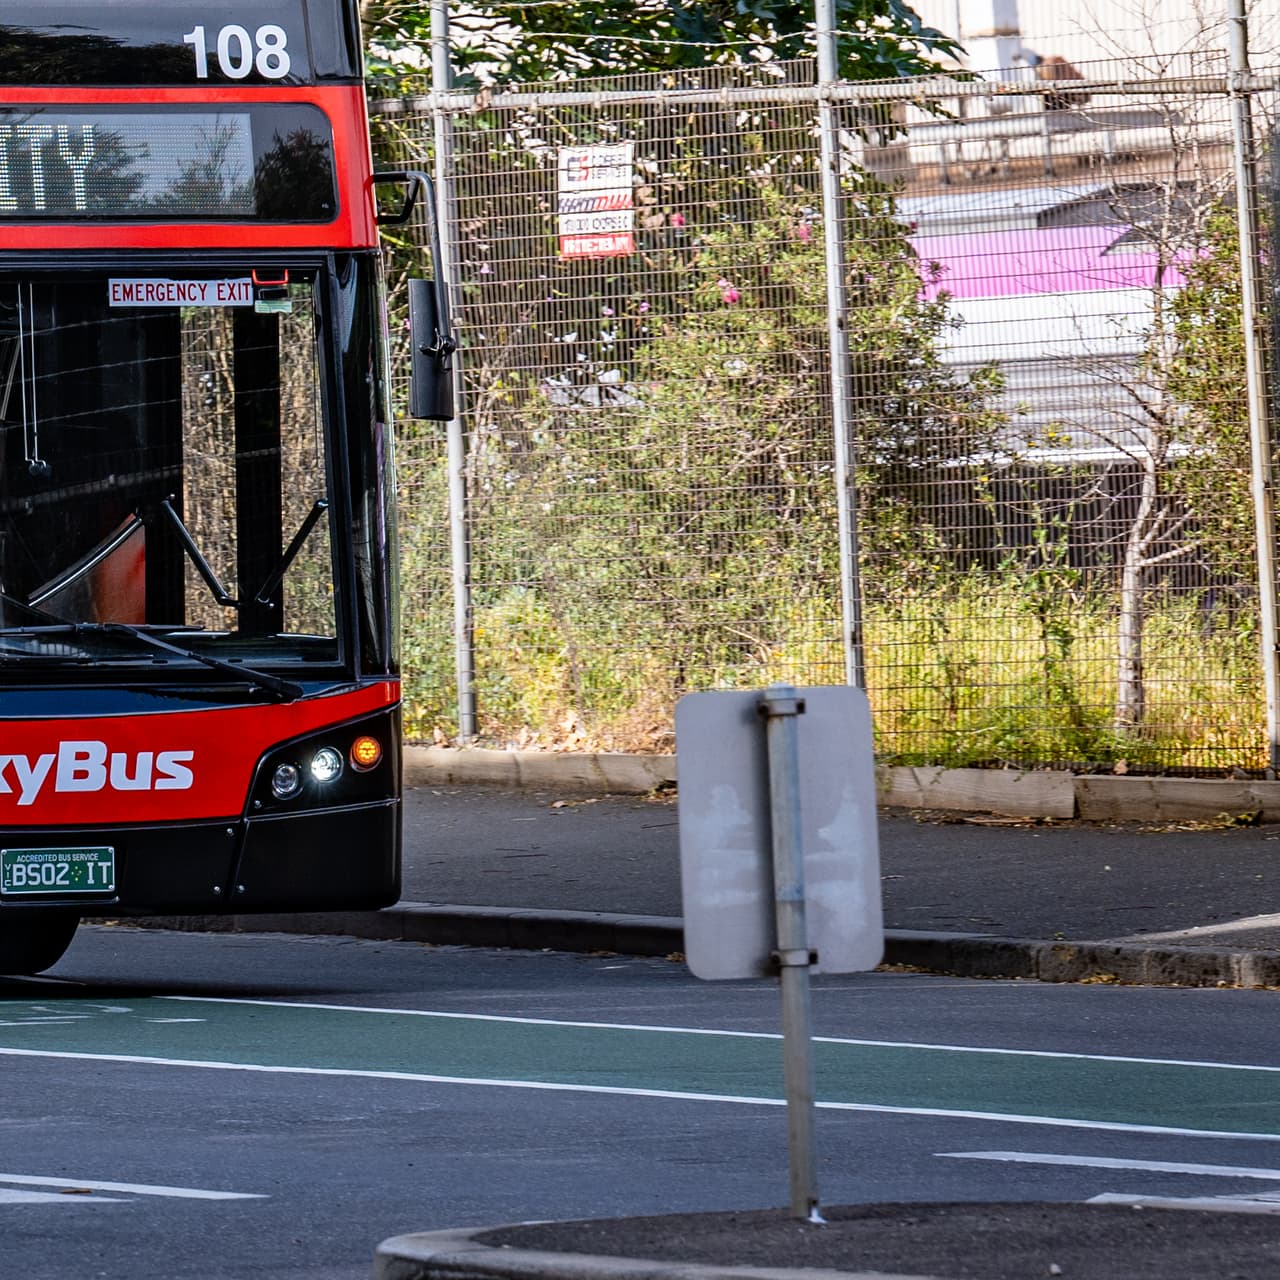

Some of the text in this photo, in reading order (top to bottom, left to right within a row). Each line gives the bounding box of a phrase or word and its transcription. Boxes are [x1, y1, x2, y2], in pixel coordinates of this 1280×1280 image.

[183, 24, 291, 79] 108
[111, 282, 251, 302] EMERGENCY EXIT
[16, 852, 99, 863] ACCREDITED BUS SERVICE
[4, 863, 12, 887] VIC
